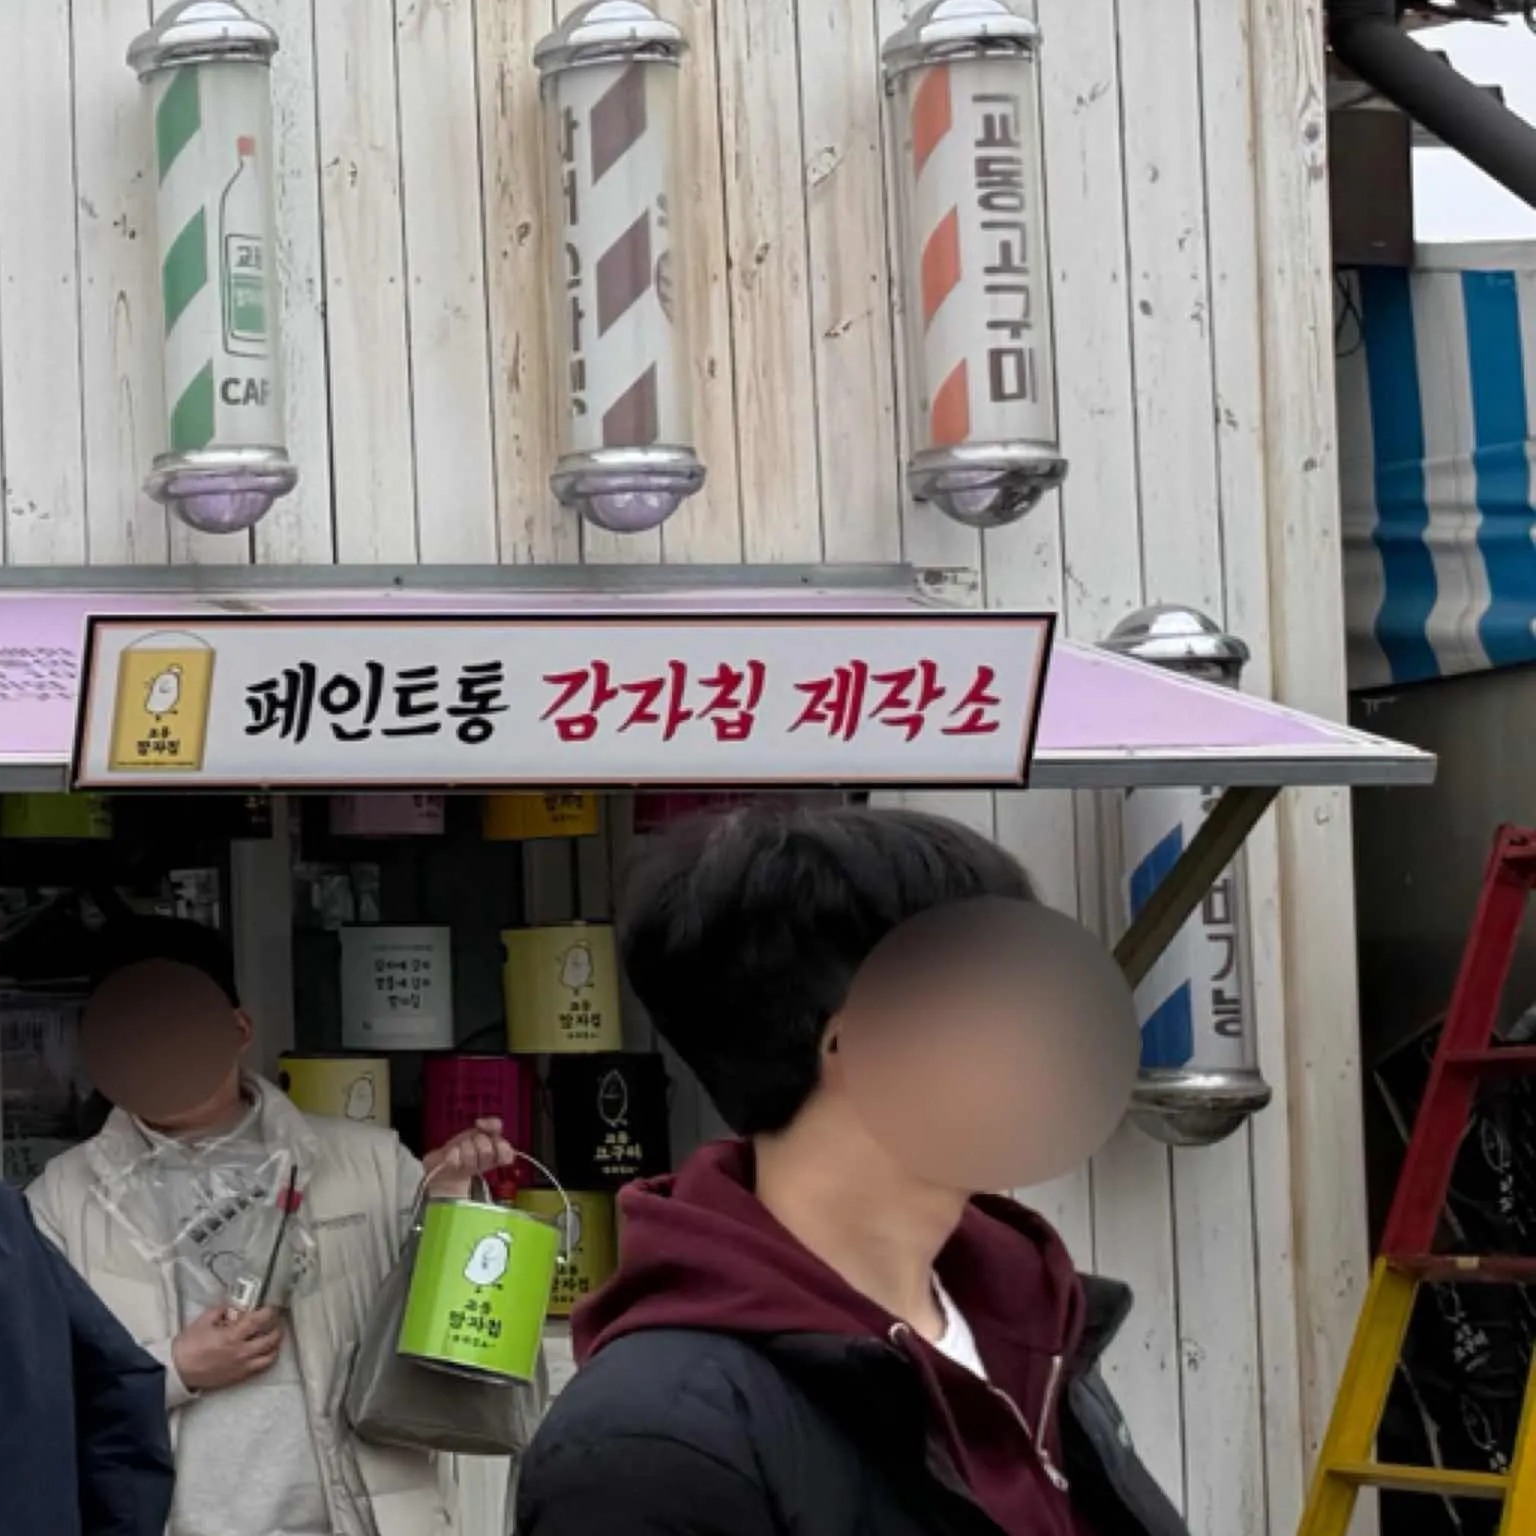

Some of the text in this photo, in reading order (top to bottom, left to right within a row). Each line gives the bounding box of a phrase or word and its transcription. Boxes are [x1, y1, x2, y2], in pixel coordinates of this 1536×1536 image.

[243, 658, 1003, 744] 페인트통 감자칩 제작소
